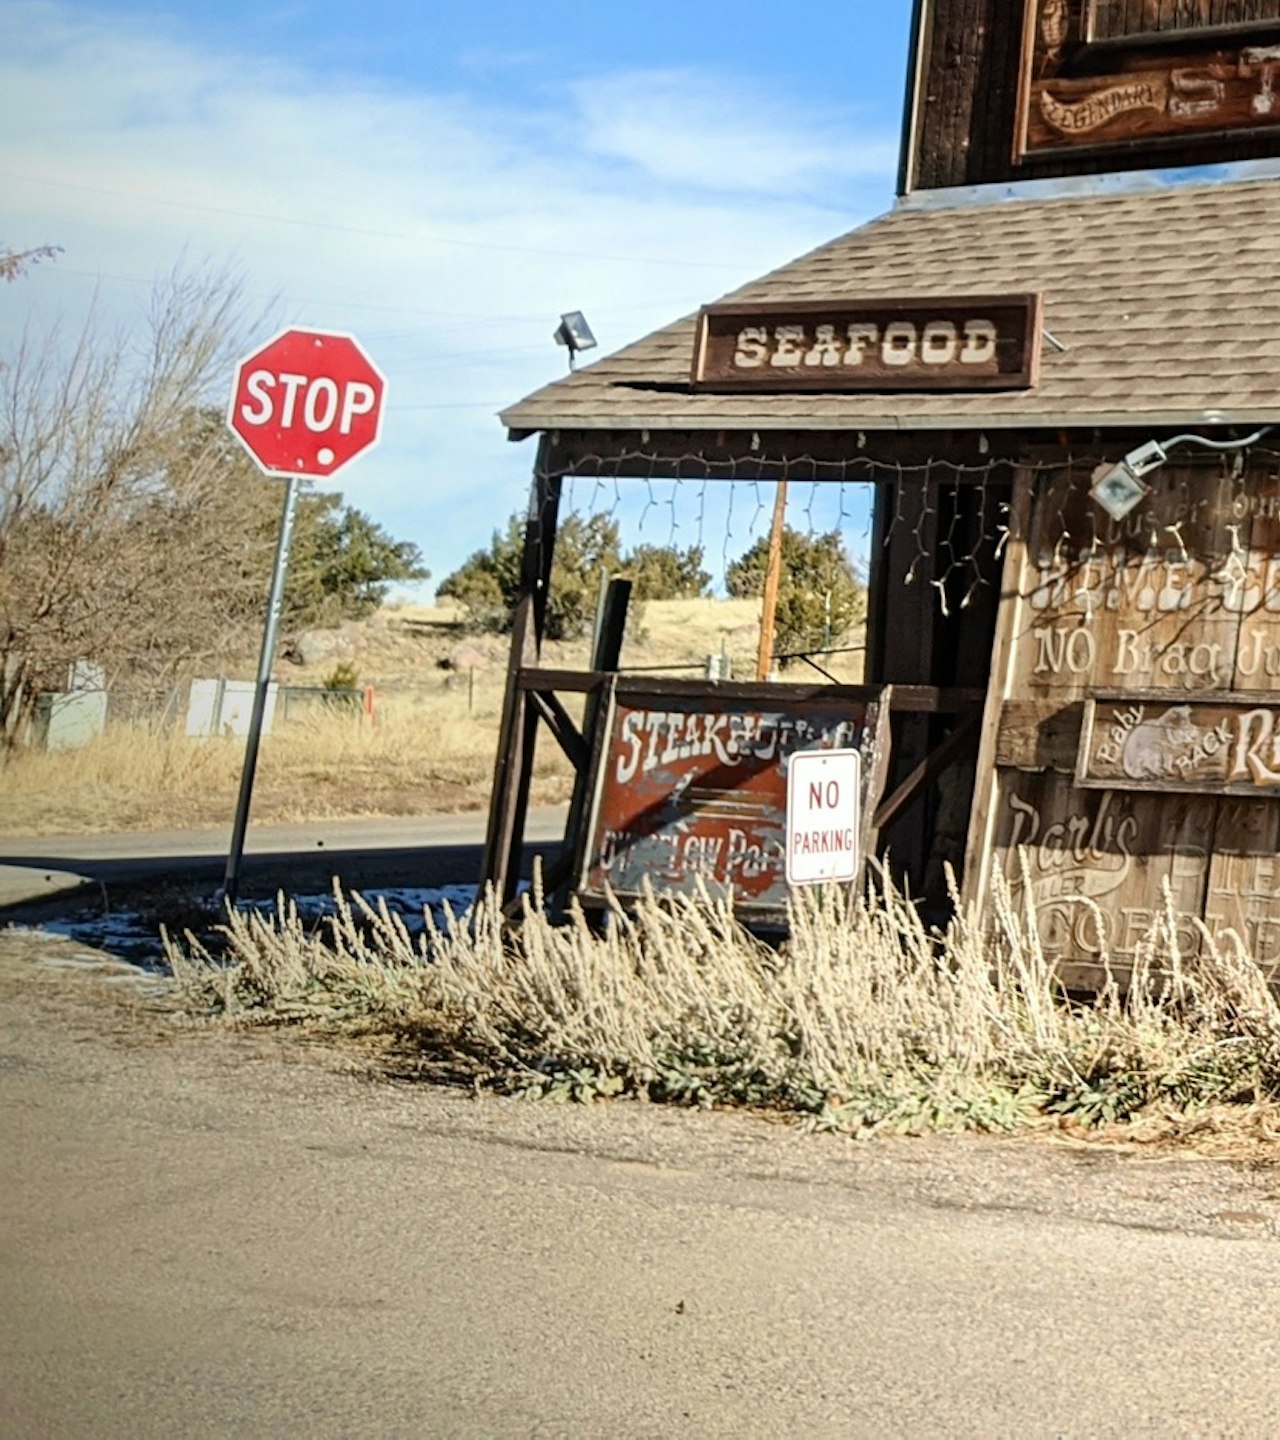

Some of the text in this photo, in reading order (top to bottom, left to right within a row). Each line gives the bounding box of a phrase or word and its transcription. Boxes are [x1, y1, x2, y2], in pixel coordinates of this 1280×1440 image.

[734, 319, 996, 368] SEAFOOD
[241, 370, 375, 434] STOP
[1034, 627, 1096, 675] NO
[1114, 629, 1221, 689] Brag
[1101, 704, 1147, 764] Baby
[1176, 718, 1236, 773] BACK
[809, 780, 841, 809] NO
[794, 828, 853, 856] PARKING
[1031, 876, 1086, 902] ILLER
